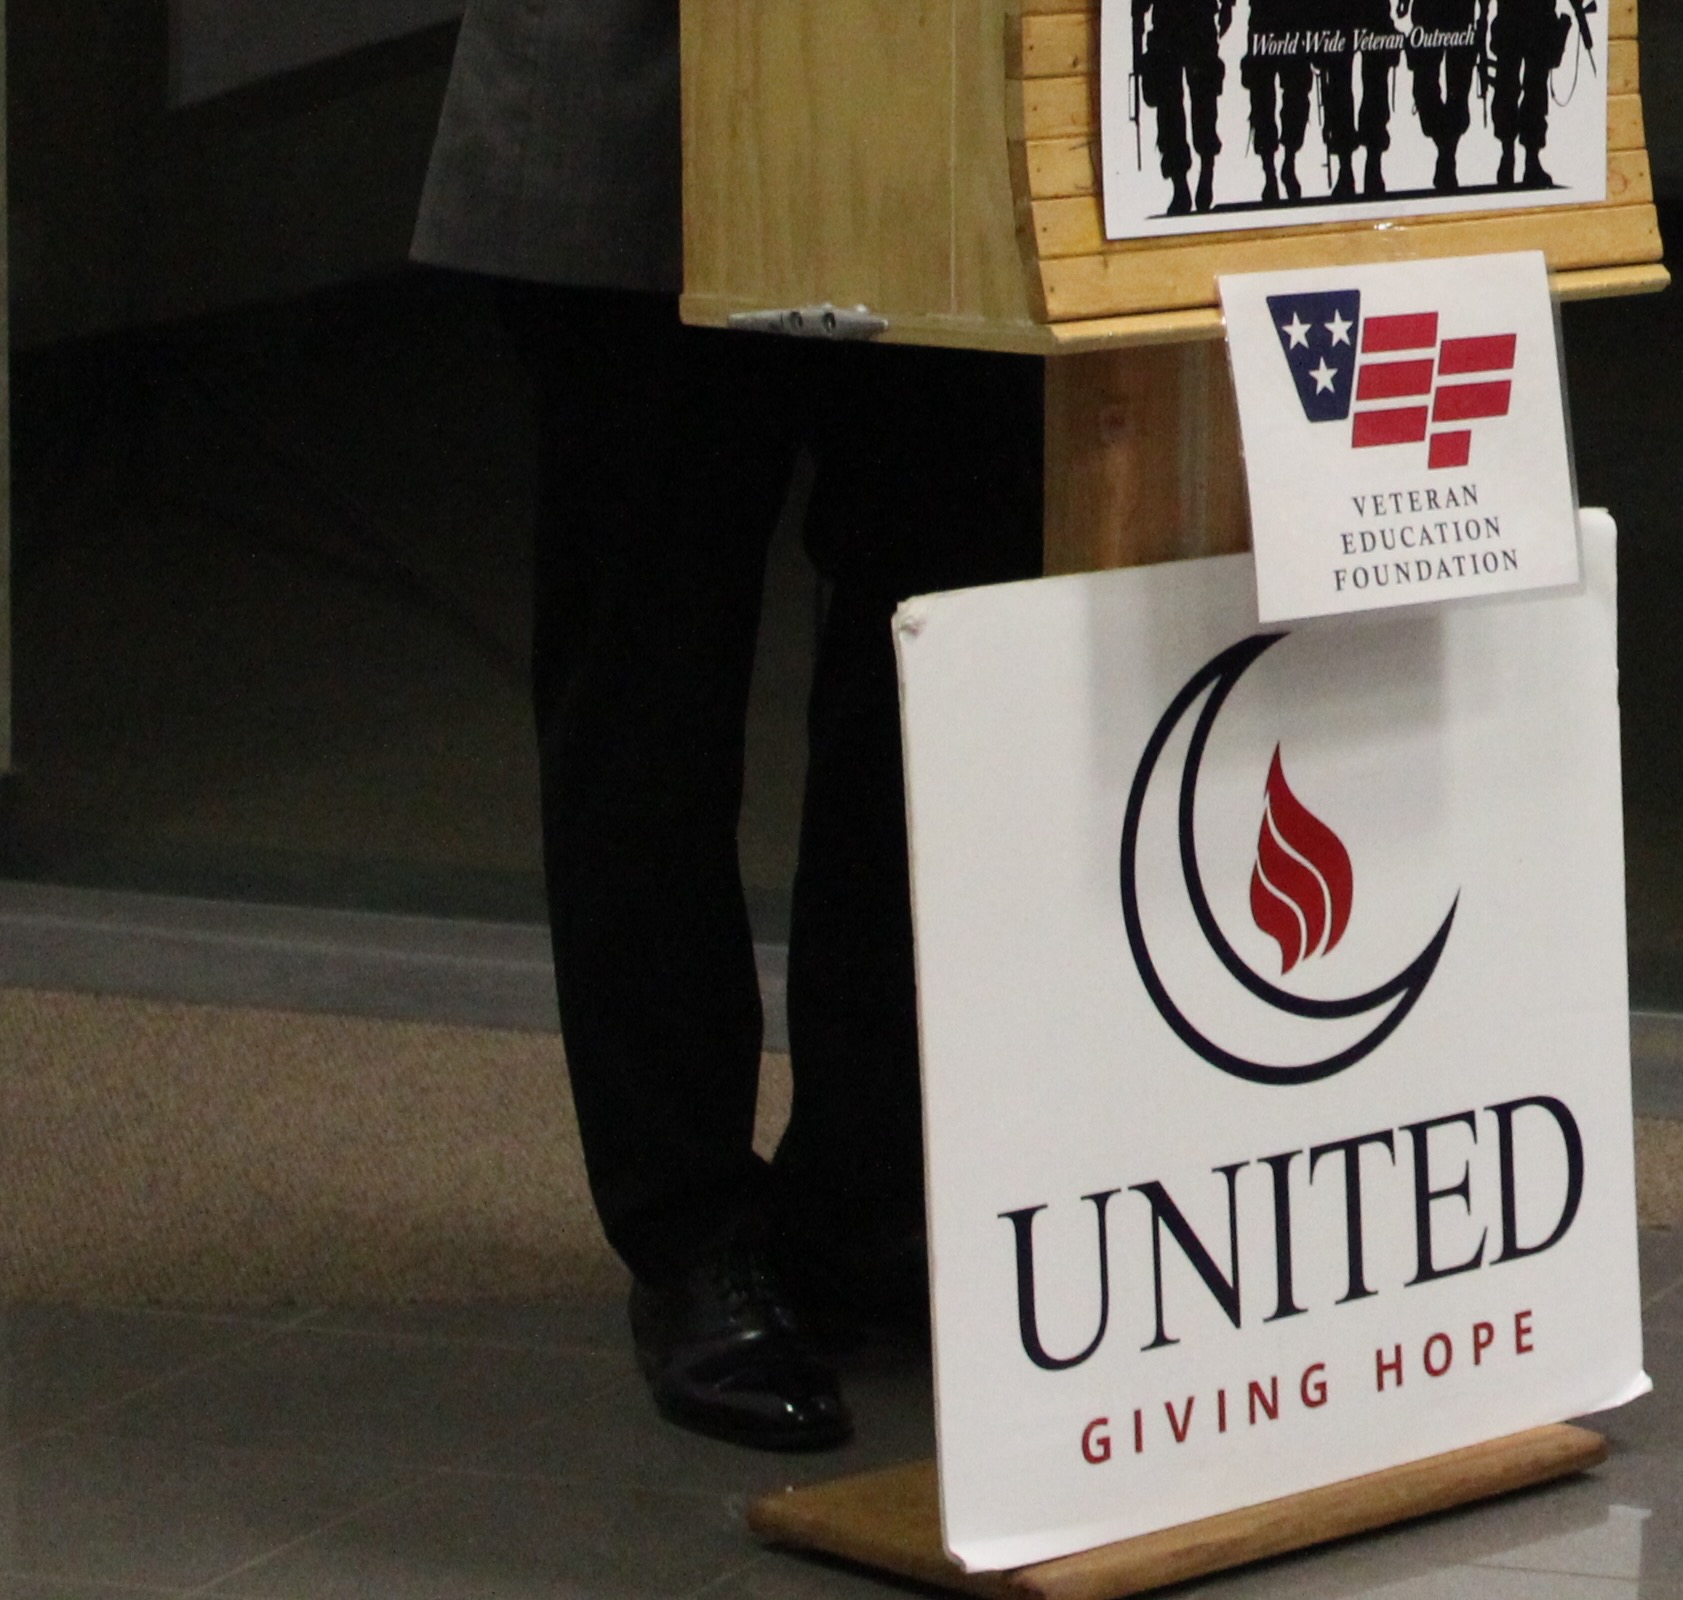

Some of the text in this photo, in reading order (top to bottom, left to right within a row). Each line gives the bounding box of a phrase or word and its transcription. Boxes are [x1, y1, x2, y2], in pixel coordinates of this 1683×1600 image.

[1252, 23, 1475, 56] World Wide Veteran Outreach
[1352, 483, 1481, 519] VETERAN
[1341, 516, 1503, 556] EDUCATION
[1334, 548, 1520, 593] FOUNDATION
[997, 1094, 1586, 1371] UNITED
[1080, 1308, 1536, 1465] GIVING HOPE
